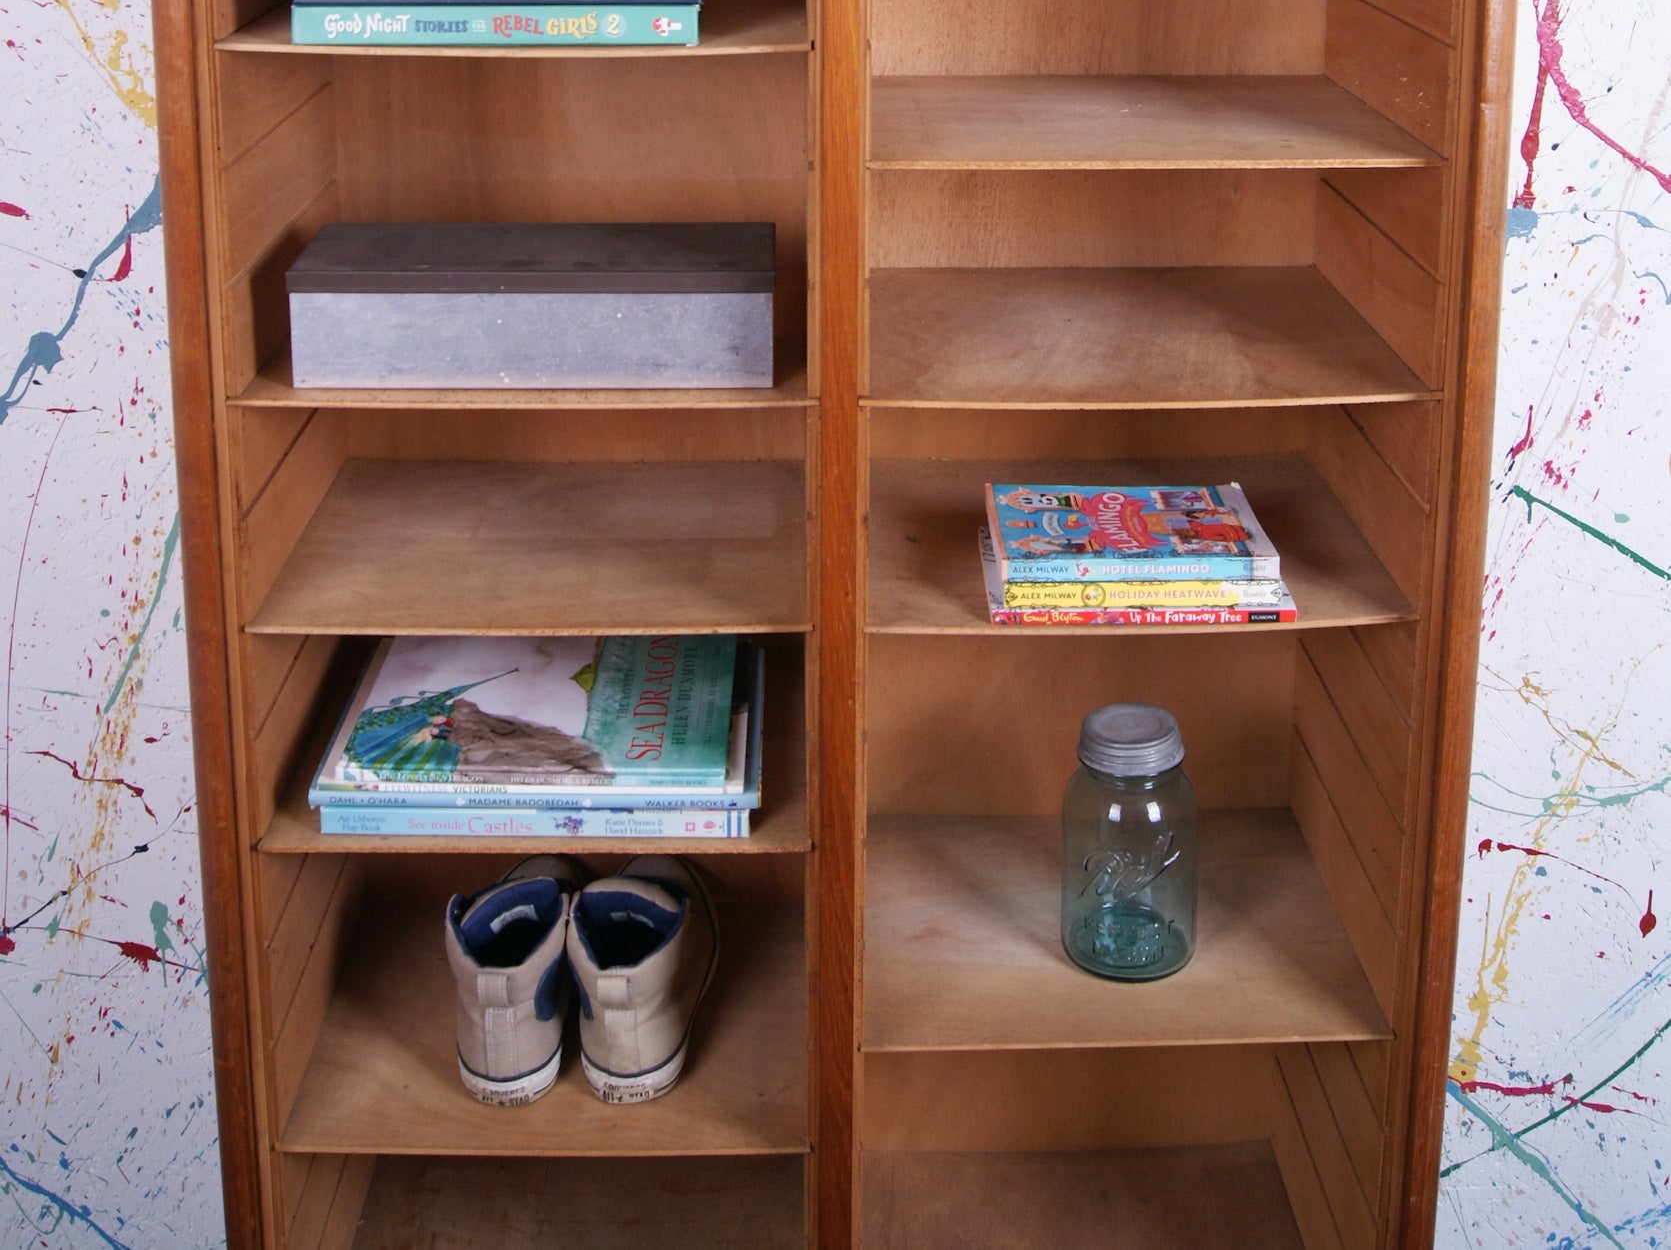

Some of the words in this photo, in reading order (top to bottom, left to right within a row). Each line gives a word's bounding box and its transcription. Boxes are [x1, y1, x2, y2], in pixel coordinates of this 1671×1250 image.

[324, 12, 363, 39] GOOD
[414, 20, 469, 33] STORIES
[492, 14, 544, 38] REBEL
[605, 13, 620, 35] 2
[1098, 492, 1147, 553] FLAMINGO
[1102, 565, 1141, 574] HOTEL
[1144, 564, 1210, 575] FLAMINGO
[1109, 590, 1160, 599] HOLIDAY
[1164, 590, 1227, 598] HEATWAVE
[1023, 611, 1049, 623] Enid
[1051, 611, 1084, 623] Blyton
[1129, 612, 1142, 624] Up
[1145, 612, 1161, 623] The
[1164, 611, 1216, 624] Faraway
[1218, 611, 1243, 623] Tree
[633, 635, 679, 718] DRAGON
[678, 645, 699, 701] DUNMORE
[616, 702, 629, 720] THE
[671, 705, 689, 745] HELEN
[625, 722, 666, 761] SEA
[384, 785, 449, 793] EYEWITNESS
[453, 785, 508, 794] VICTORIANS
[329, 795, 357, 804] DAHL
[367, 796, 407, 805] O'HARA
[468, 798, 511, 806] MADAME
[515, 798, 579, 807] BADOBEDAH
[338, 814, 351, 822] An
[353, 814, 386, 822] Usborne
[605, 818, 626, 826] Katie
[342, 823, 359, 832] Flap
[361, 823, 381, 831] Book
[408, 818, 427, 829] See
[431, 818, 464, 829] inside
[468, 816, 534, 834] Castles
